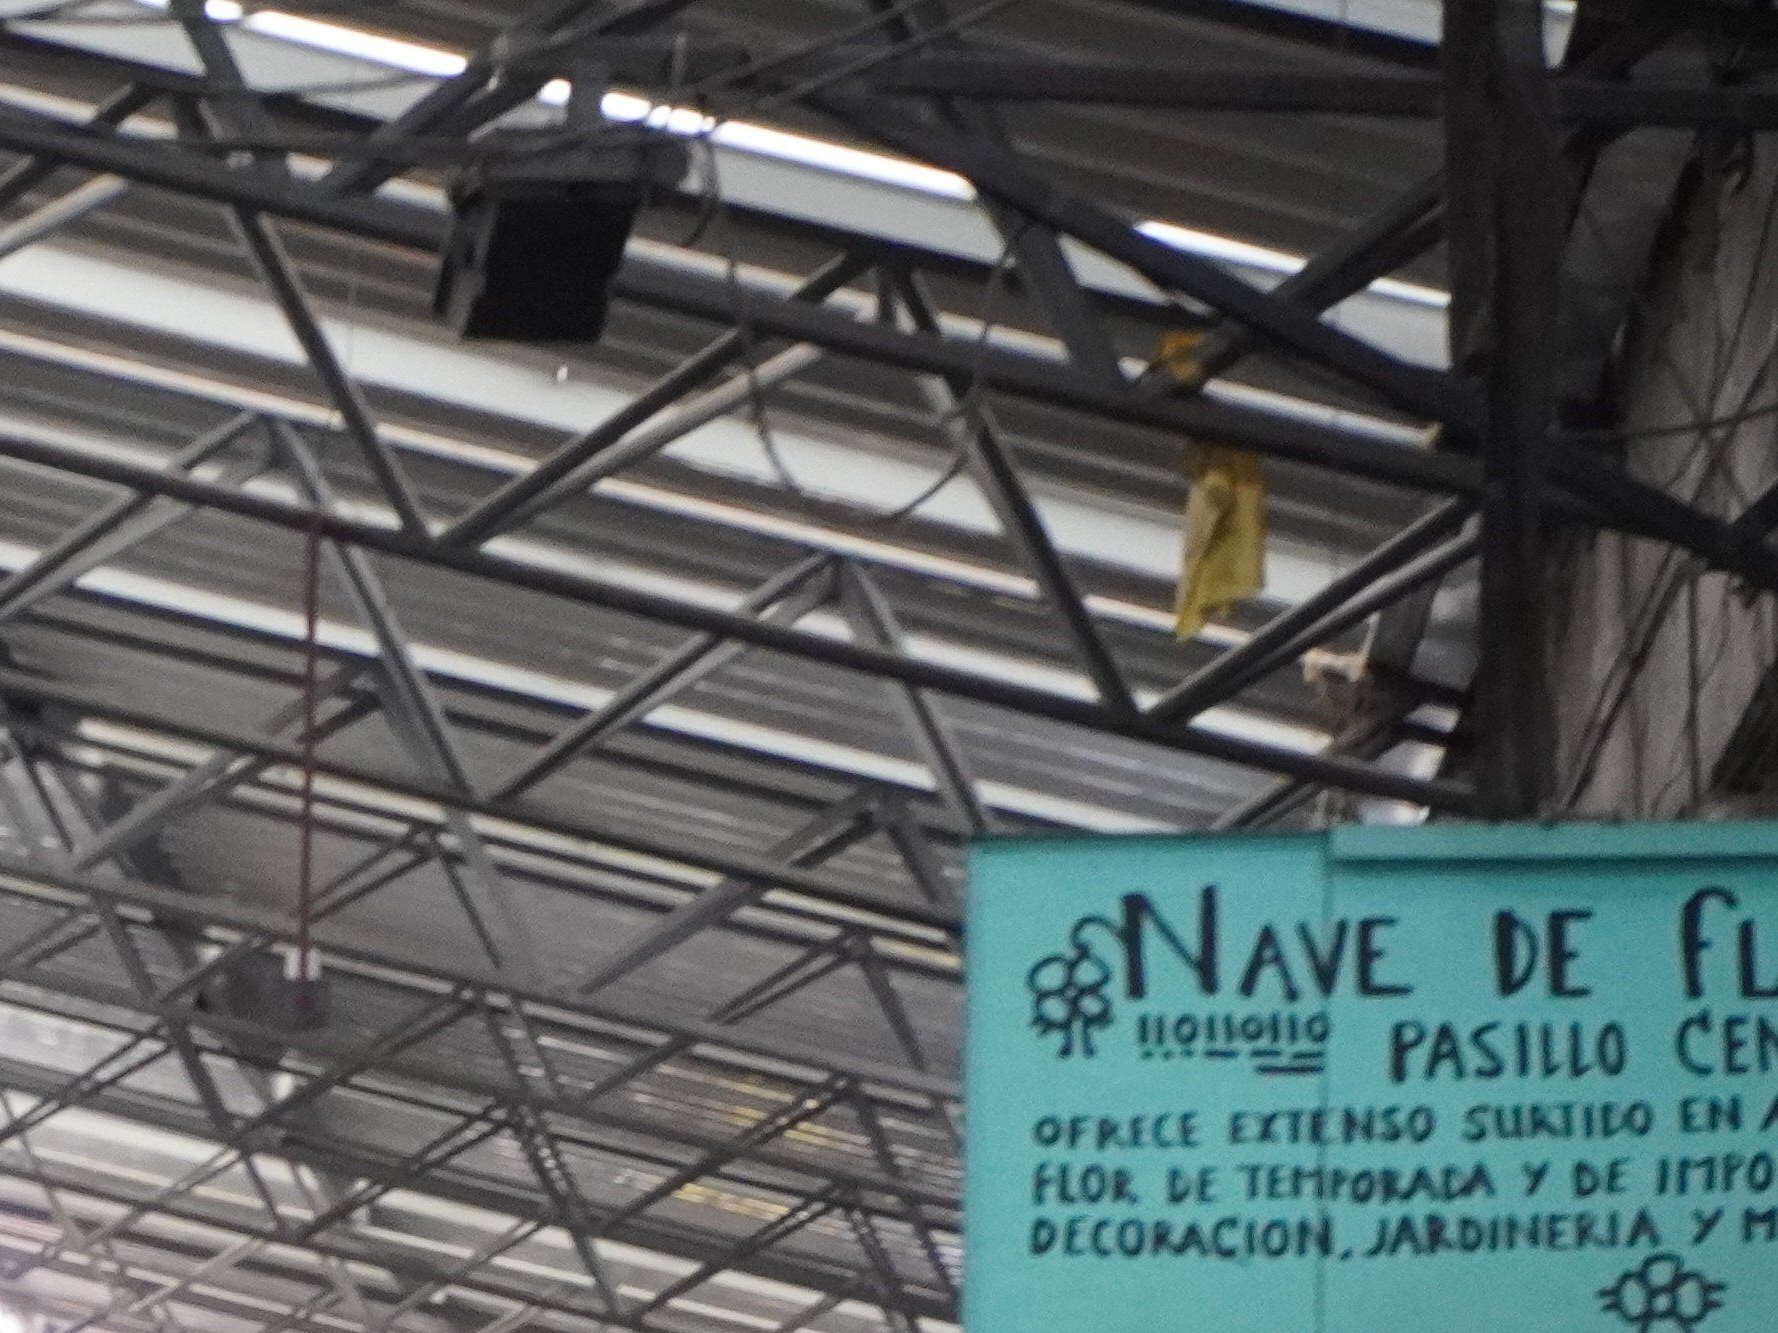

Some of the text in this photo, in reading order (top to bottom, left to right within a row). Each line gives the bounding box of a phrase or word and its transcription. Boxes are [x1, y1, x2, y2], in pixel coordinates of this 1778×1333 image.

[1118, 883, 1414, 1001] NAVE
[1495, 906, 1595, 997] DE
[1389, 1019, 1629, 1083] PASILLO
[1032, 1112, 1200, 1149] OFRECE
[1227, 1103, 1436, 1147] EXTENSO
[1460, 1099, 1655, 1143] SURTIDO
[1678, 1094, 1742, 1133] EN
[1032, 1149, 1775, 1206] FLOR DE TEMPORADA Y DE IMPO
[1365, 1204, 1663, 1257] JARDINERIA
[1689, 1206, 1724, 1245] Y
